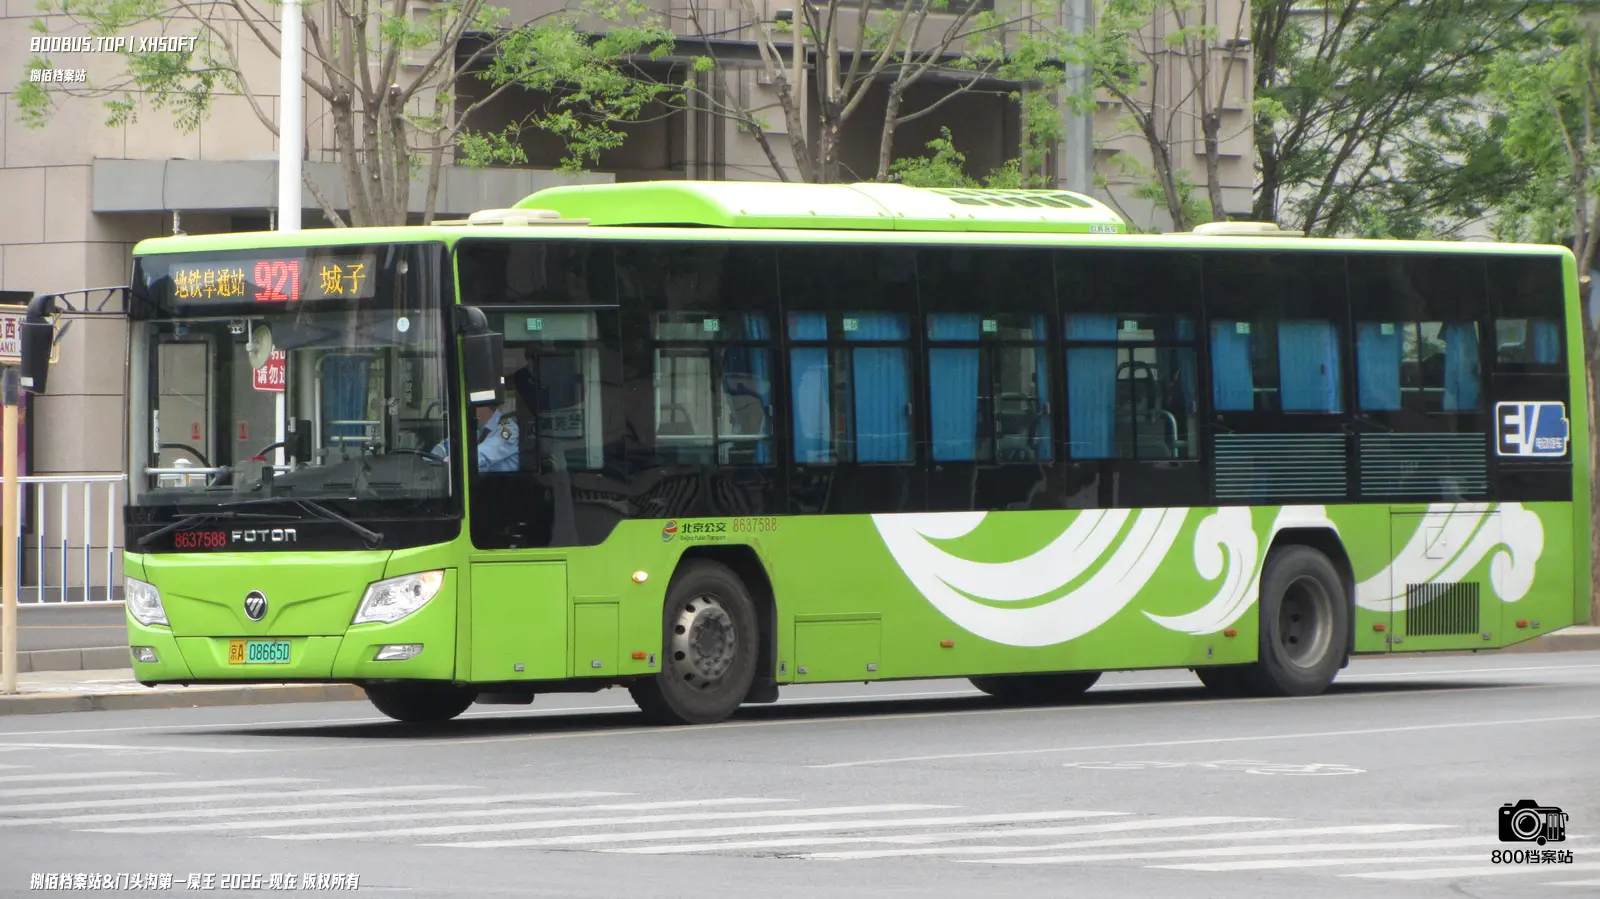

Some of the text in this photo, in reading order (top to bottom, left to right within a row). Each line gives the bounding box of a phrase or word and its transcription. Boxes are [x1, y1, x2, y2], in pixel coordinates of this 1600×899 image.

[174, 260, 366, 301] 地铁阜通站 921 城子
[1498, 402, 1541, 455] EV
[174, 528, 297, 548] 8637588 FOTON
[681, 517, 778, 534] 北京公交 8637588
